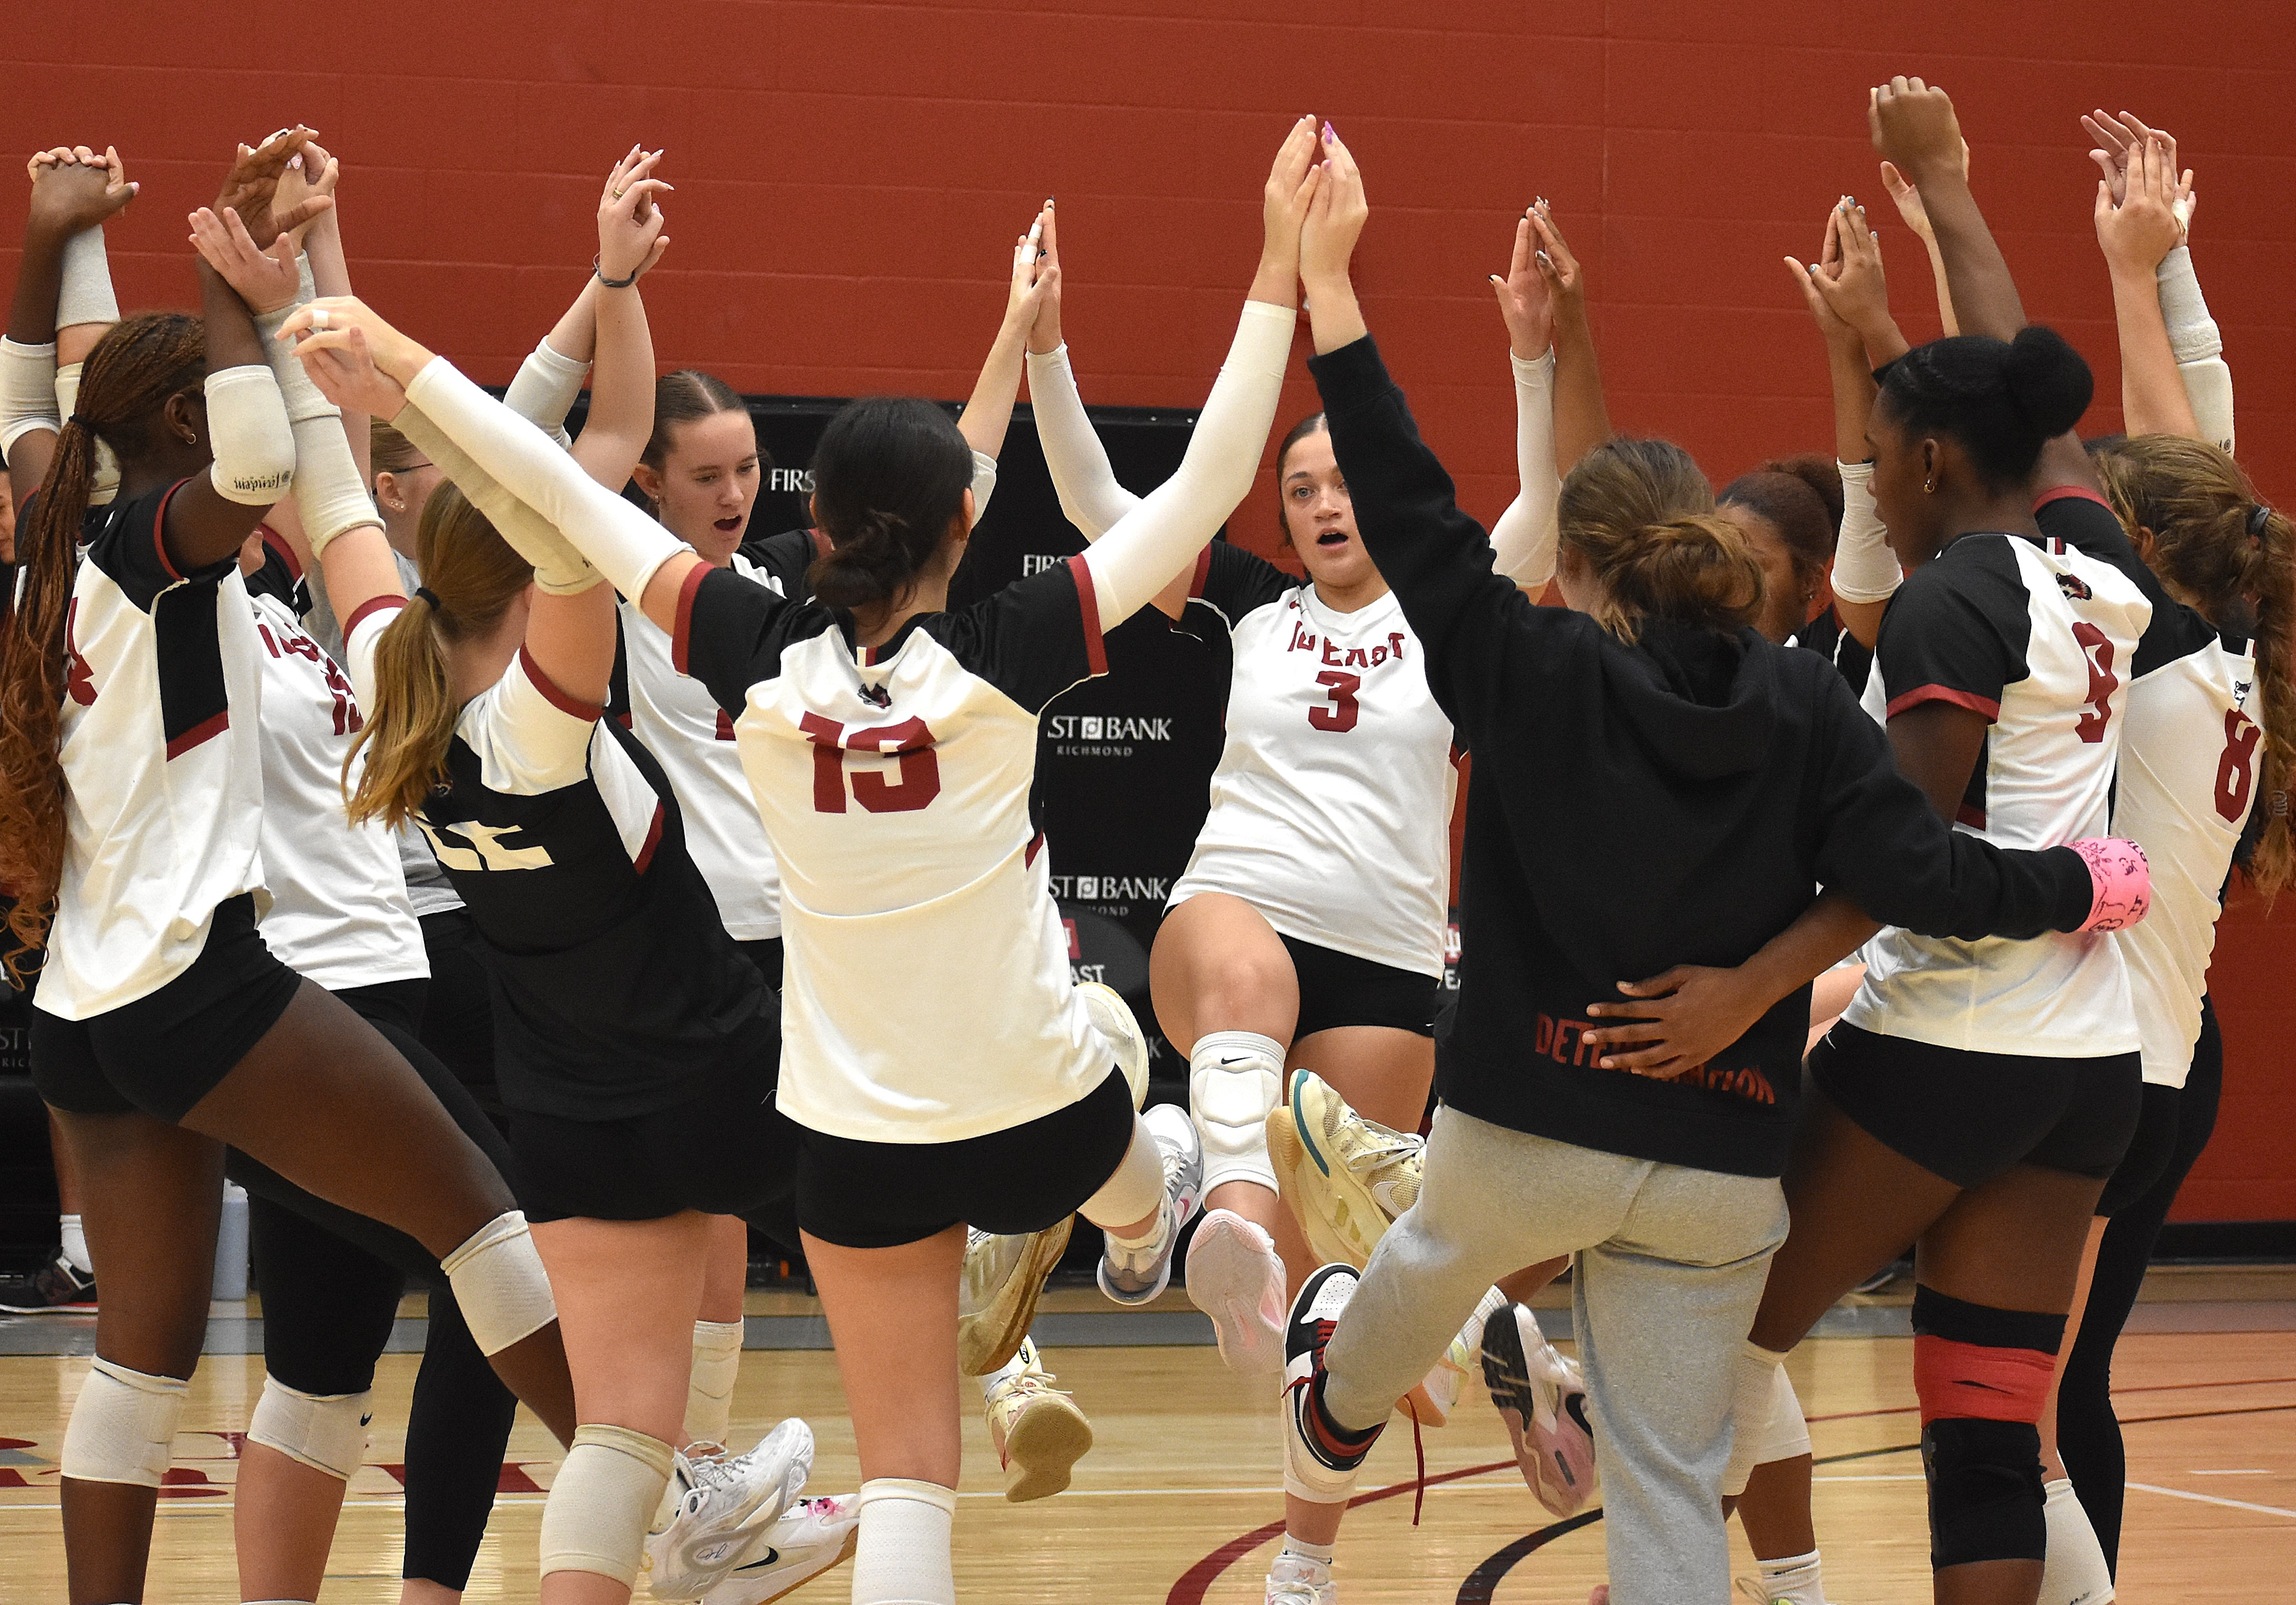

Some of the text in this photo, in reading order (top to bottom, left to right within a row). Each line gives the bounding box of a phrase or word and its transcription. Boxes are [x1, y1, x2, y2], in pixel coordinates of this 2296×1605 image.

[1308, 671, 1361, 733] 3
[2072, 621, 2119, 743] 9
[1106, 716, 1173, 741] BANK
[1056, 745, 1133, 757] RICHMOND
[2213, 707, 2262, 824] 8
[1102, 876, 1168, 901] BANK
